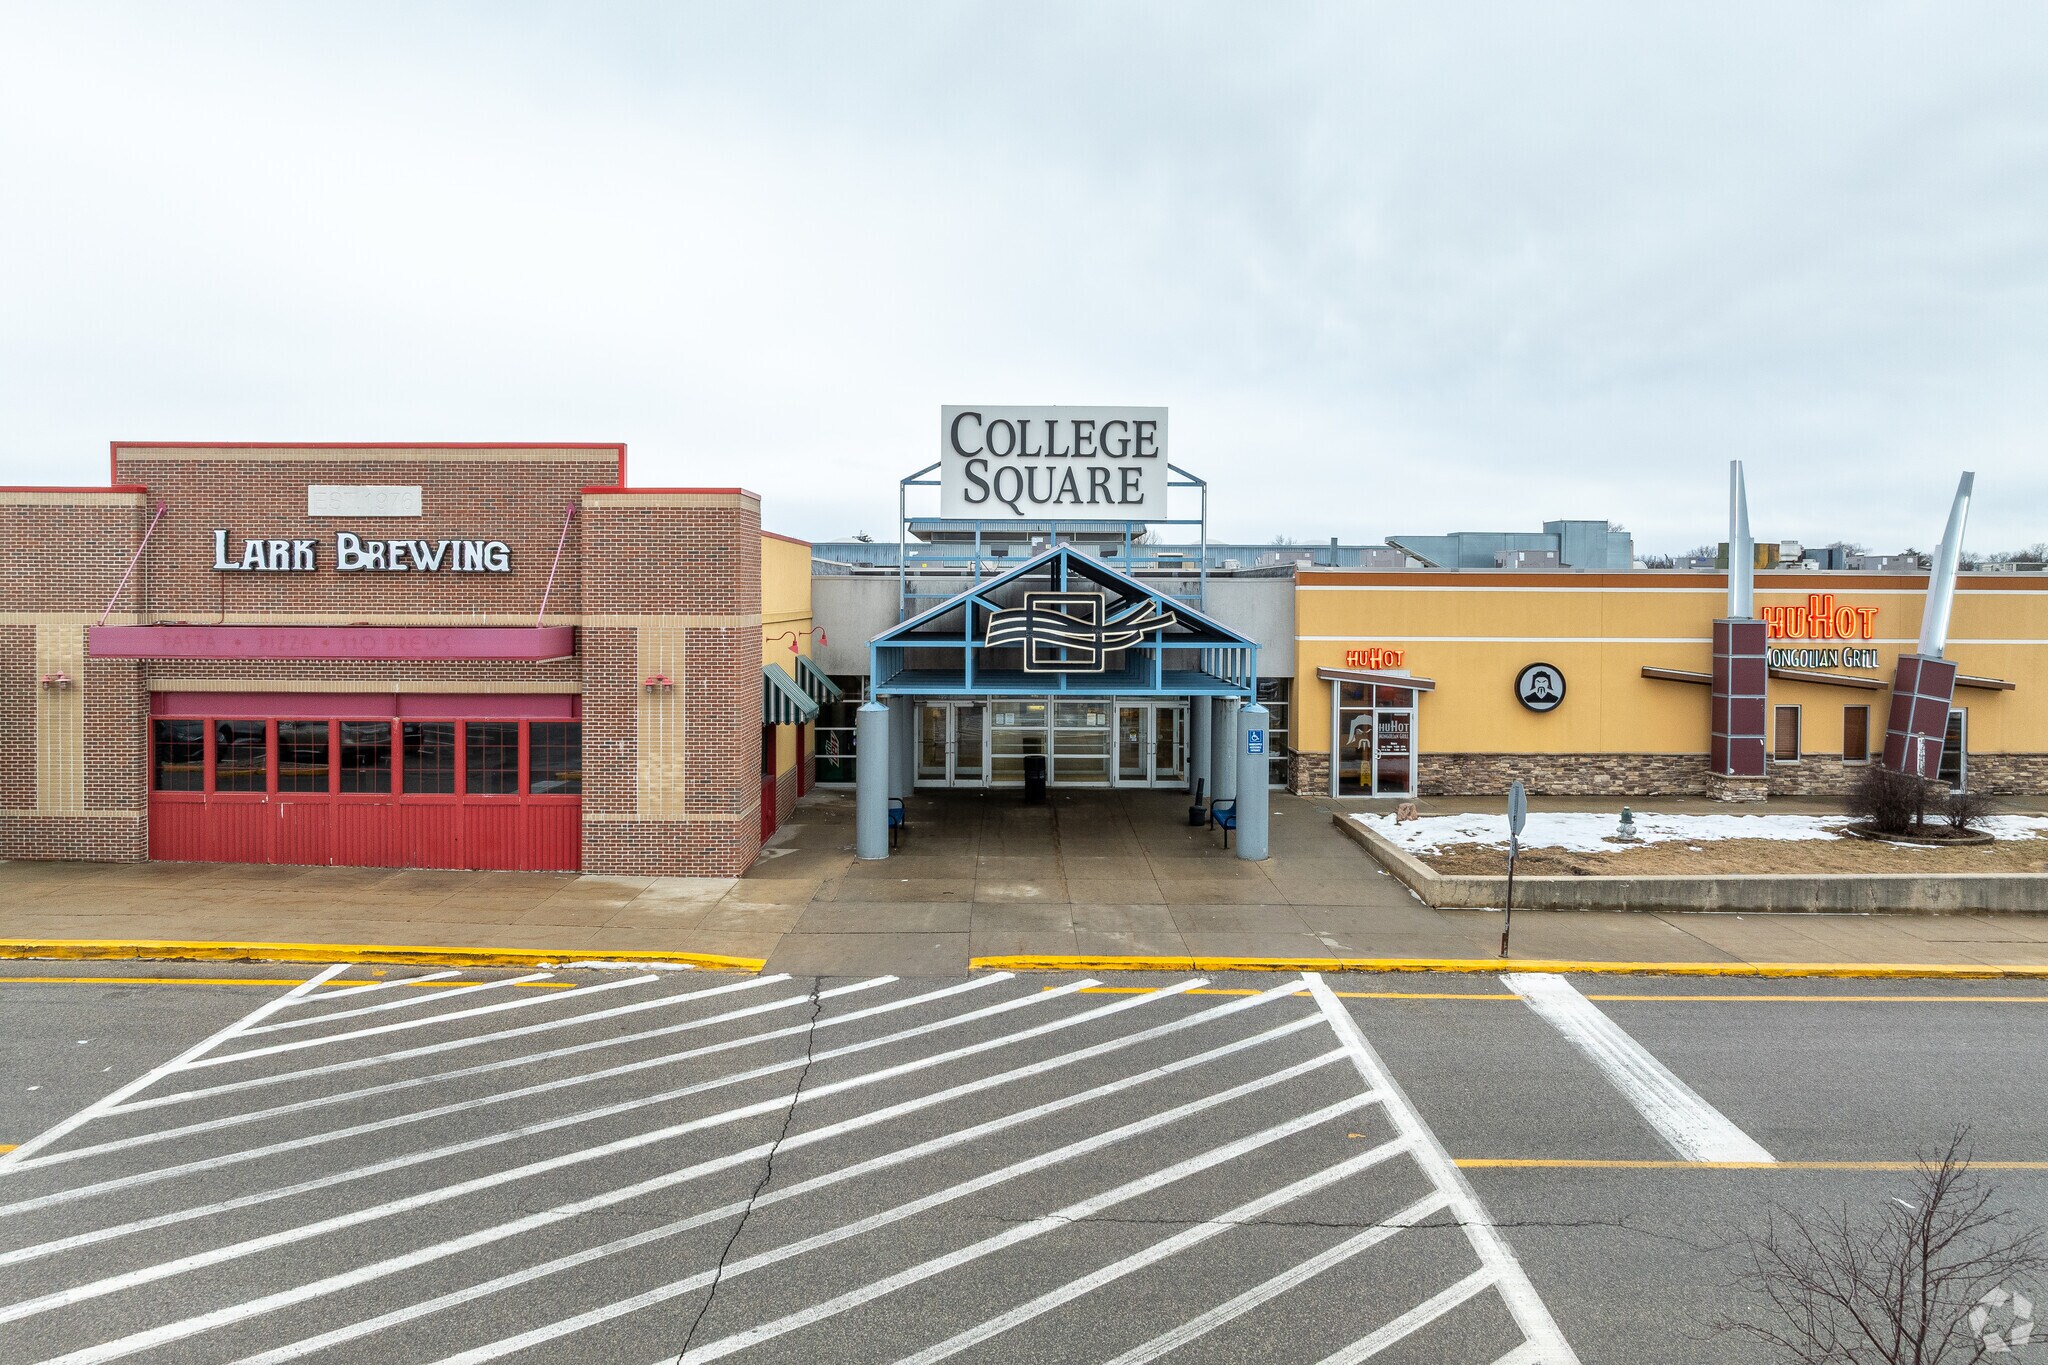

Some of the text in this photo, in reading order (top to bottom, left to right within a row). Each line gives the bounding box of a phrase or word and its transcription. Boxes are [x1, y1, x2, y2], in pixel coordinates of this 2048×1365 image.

[951, 411, 1159, 458] COLLEGE
[364, 491, 413, 510] 1976
[964, 458, 1144, 515] SQUARE
[213, 529, 512, 572] LARK BREWING
[161, 634, 217, 649] PASTA
[257, 634, 312, 649] PIZZA
[386, 634, 452, 651] BREWS
